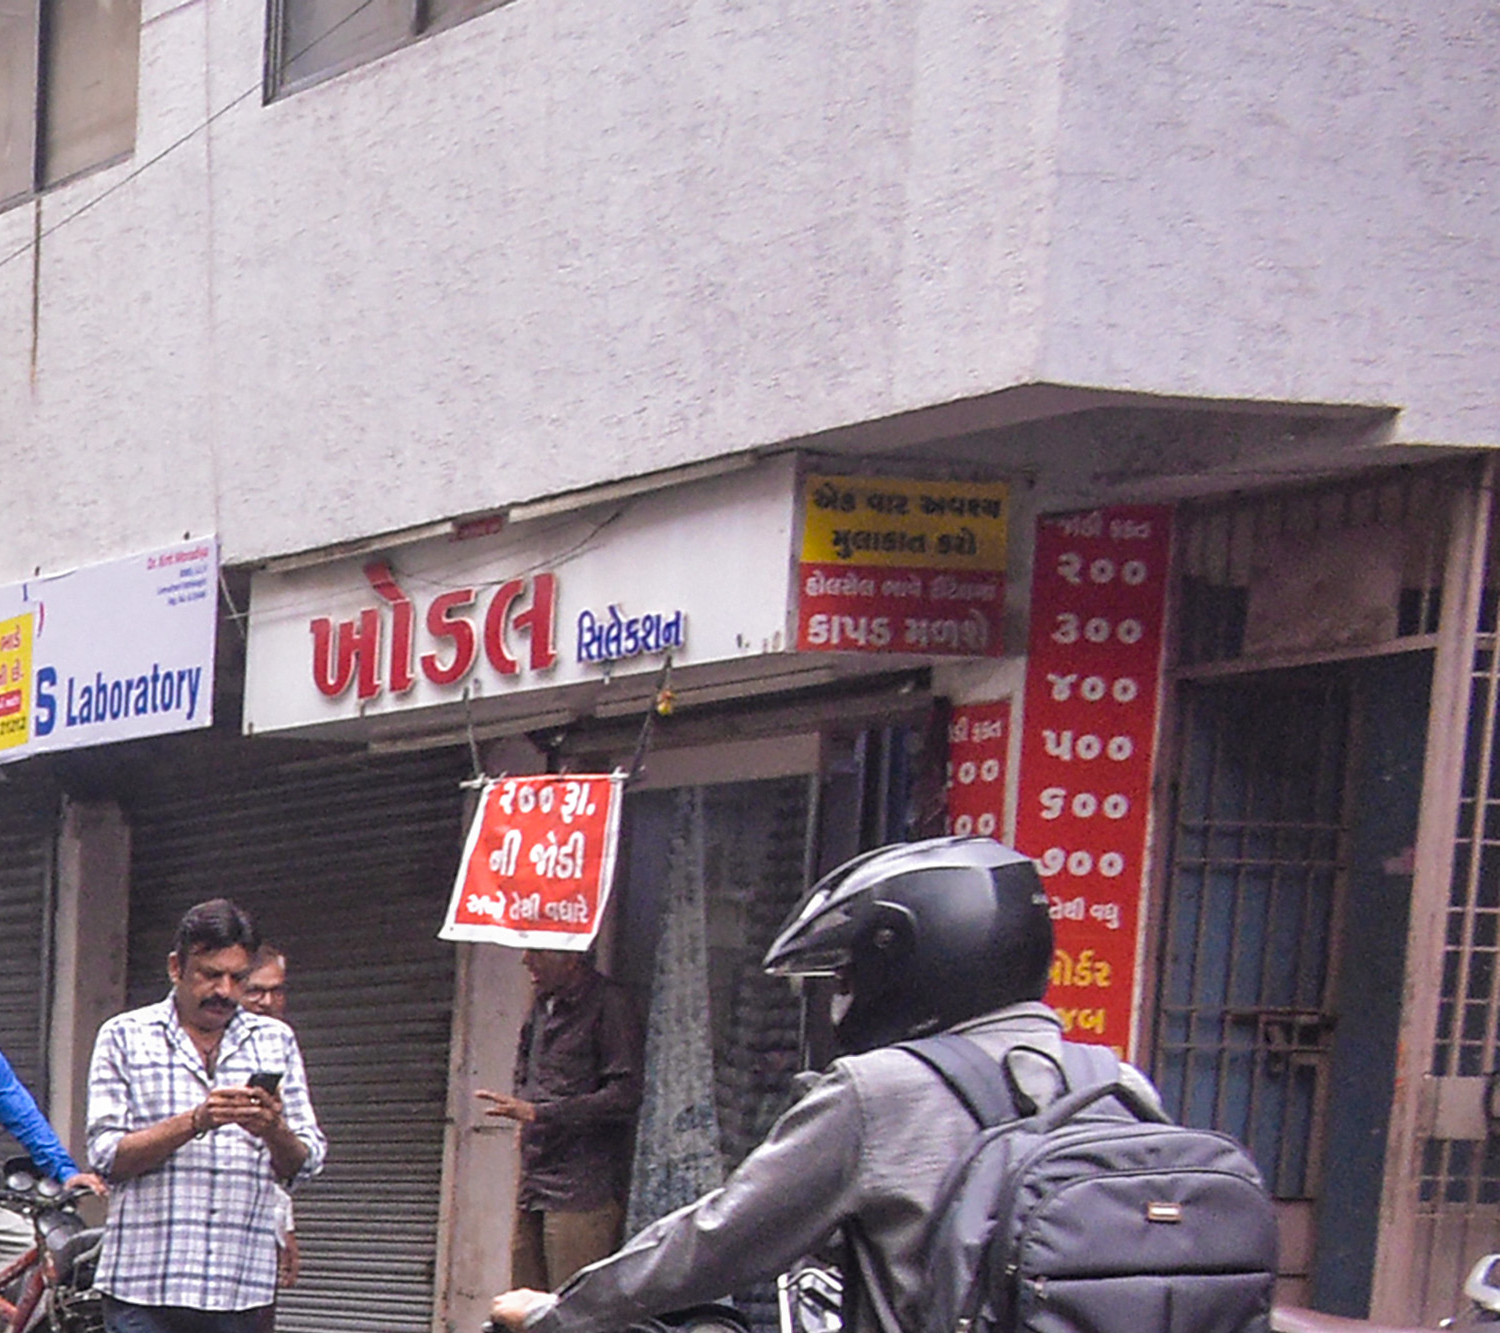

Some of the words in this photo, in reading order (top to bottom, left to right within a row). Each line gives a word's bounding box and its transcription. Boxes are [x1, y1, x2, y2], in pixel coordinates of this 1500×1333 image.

[1056, 552, 1148, 586] ૨૦૦
[309, 560, 560, 700] ખોડલ
[806, 613, 892, 648] કાપડ
[1050, 612, 1143, 645] ૩૦૦
[65, 663, 202, 727] Laboratory
[1046, 673, 1138, 703] ૪૦૦
[1041, 729, 1133, 762] ૫૦૦
[1039, 787, 1130, 820] ૬૦૦
[489, 829, 522, 877] ની
[529, 830, 585, 879] જોડી
